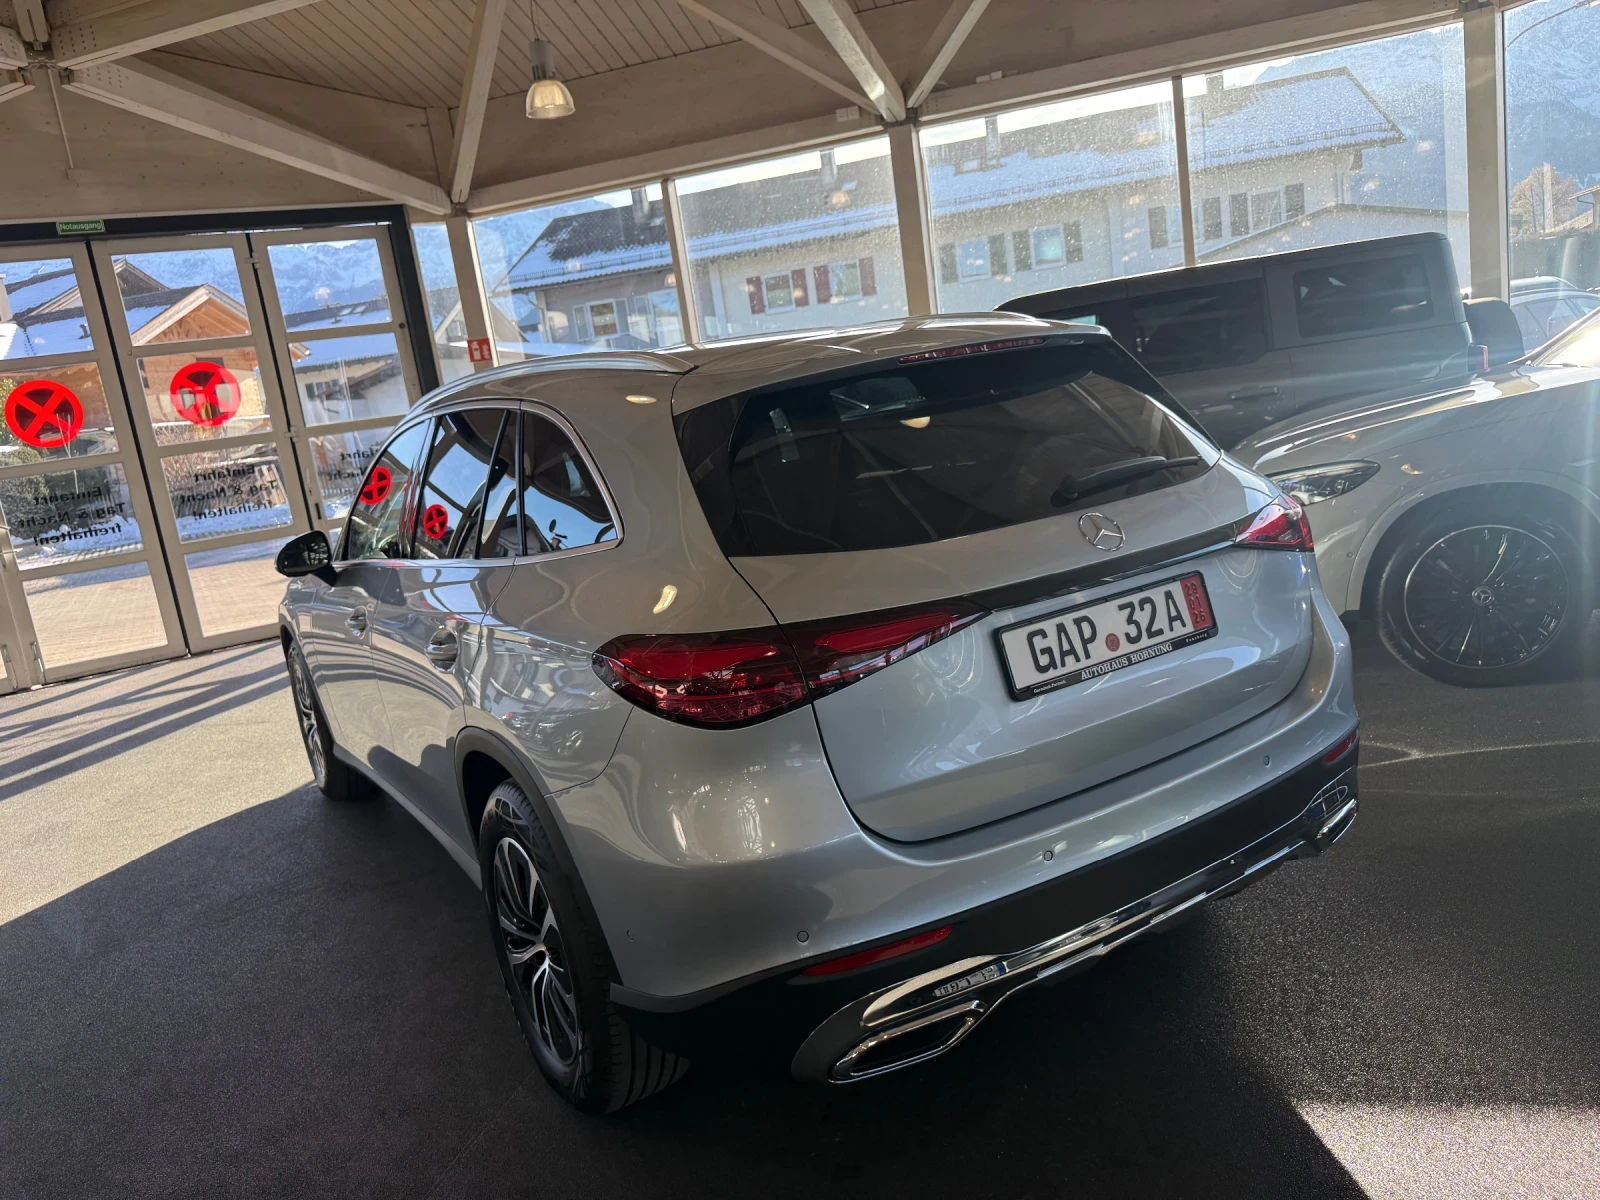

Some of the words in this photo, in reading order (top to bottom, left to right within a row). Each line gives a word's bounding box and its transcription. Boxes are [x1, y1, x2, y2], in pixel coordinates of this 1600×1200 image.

[60, 222, 102, 231] Notausgang
[1026, 615, 1098, 674] GAP
[1117, 589, 1187, 646] 32A
[1081, 657, 1129, 680] AUTOHAUS
[1131, 642, 1174, 667] HORNUNG
